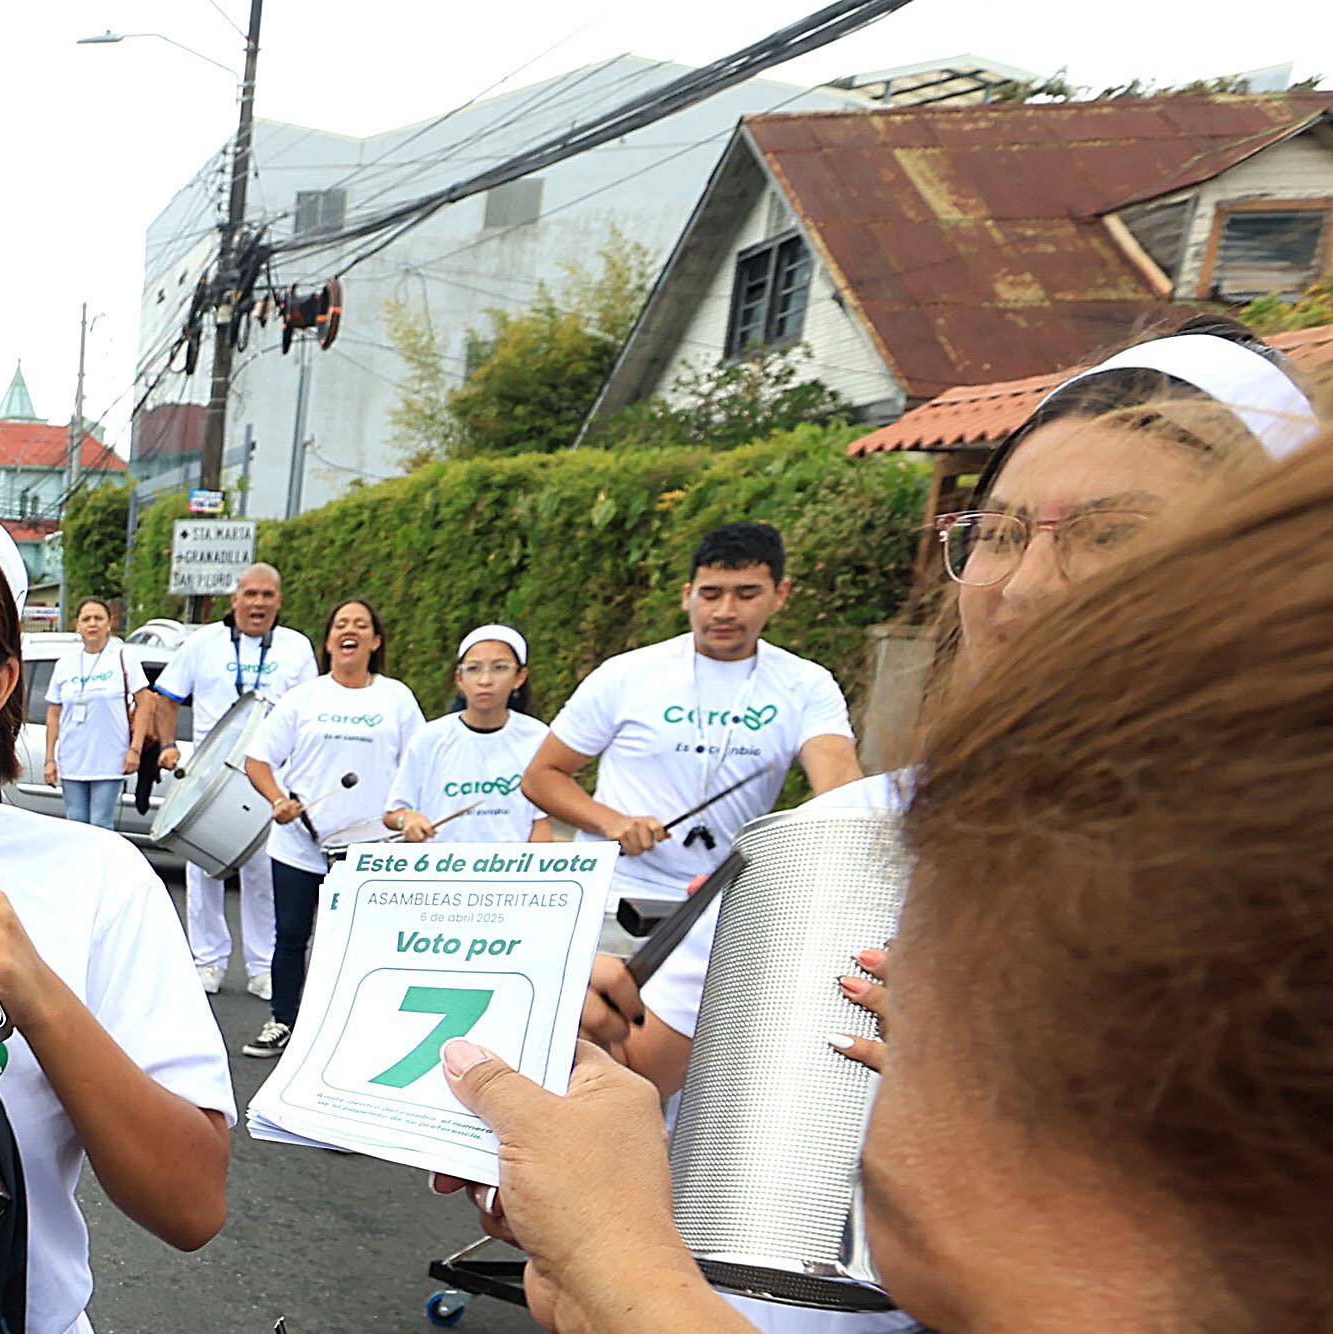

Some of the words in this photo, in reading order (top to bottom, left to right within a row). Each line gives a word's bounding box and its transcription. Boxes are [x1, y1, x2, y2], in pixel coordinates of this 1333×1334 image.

[186, 550, 250, 564] GRANADILLA
[356, 854, 408, 873] Este
[414, 854, 428, 873] 6
[436, 853, 466, 873] de
[473, 853, 533, 873] abril
[539, 855, 598, 873] vota
[367, 892, 462, 907] ASAMBLEAS
[467, 893, 568, 907] DISTRITALES
[420, 912, 427, 922] 6
[429, 912, 446, 922] de
[447, 912, 474, 923] abril
[476, 913, 505, 923] 2025
[396, 931, 461, 955] Voto
[464, 938, 522, 962] por
[367, 986, 495, 1089] 7
